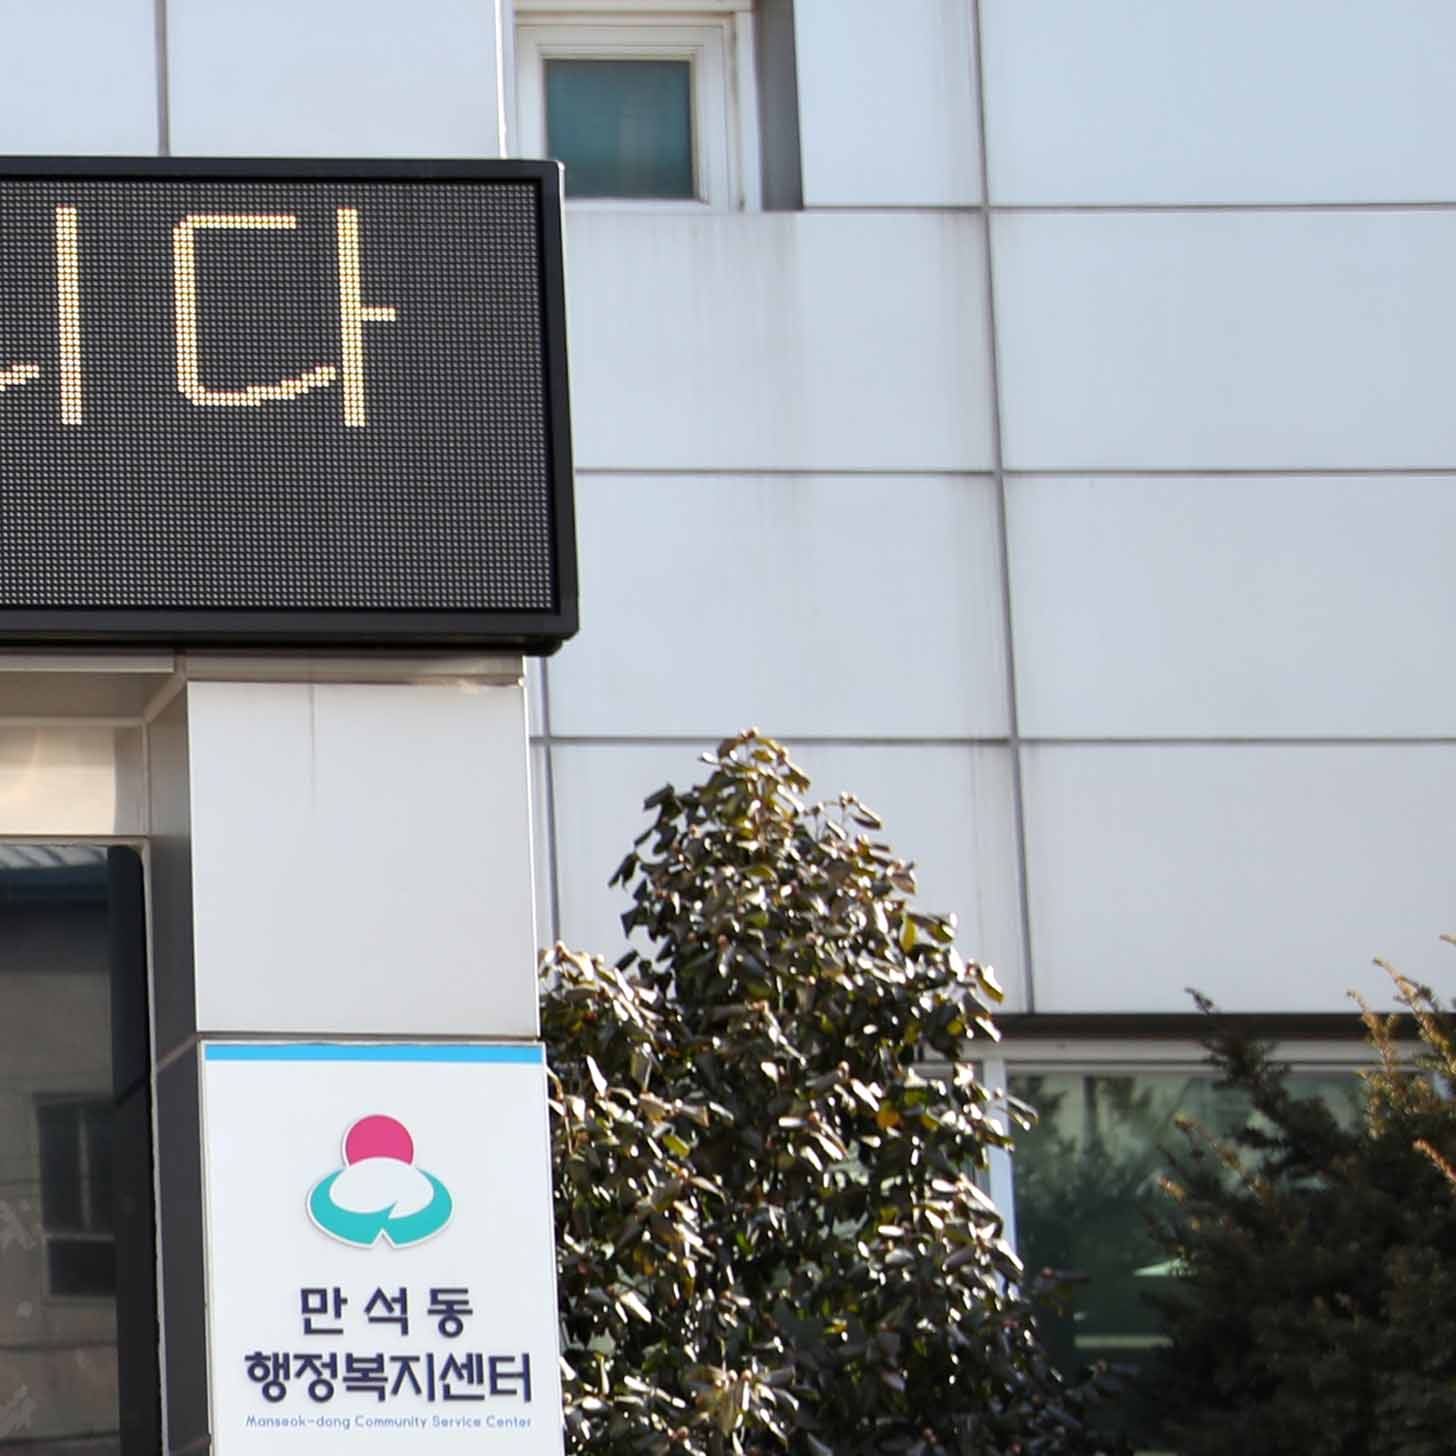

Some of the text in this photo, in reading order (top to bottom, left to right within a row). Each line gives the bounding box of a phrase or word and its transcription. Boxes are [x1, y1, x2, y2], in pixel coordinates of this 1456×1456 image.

[300, 1287, 474, 1337] 만석동
[244, 1351, 533, 1403] 행정복지센터
[245, 1414, 532, 1430] Manseok-dong Community Service Center
